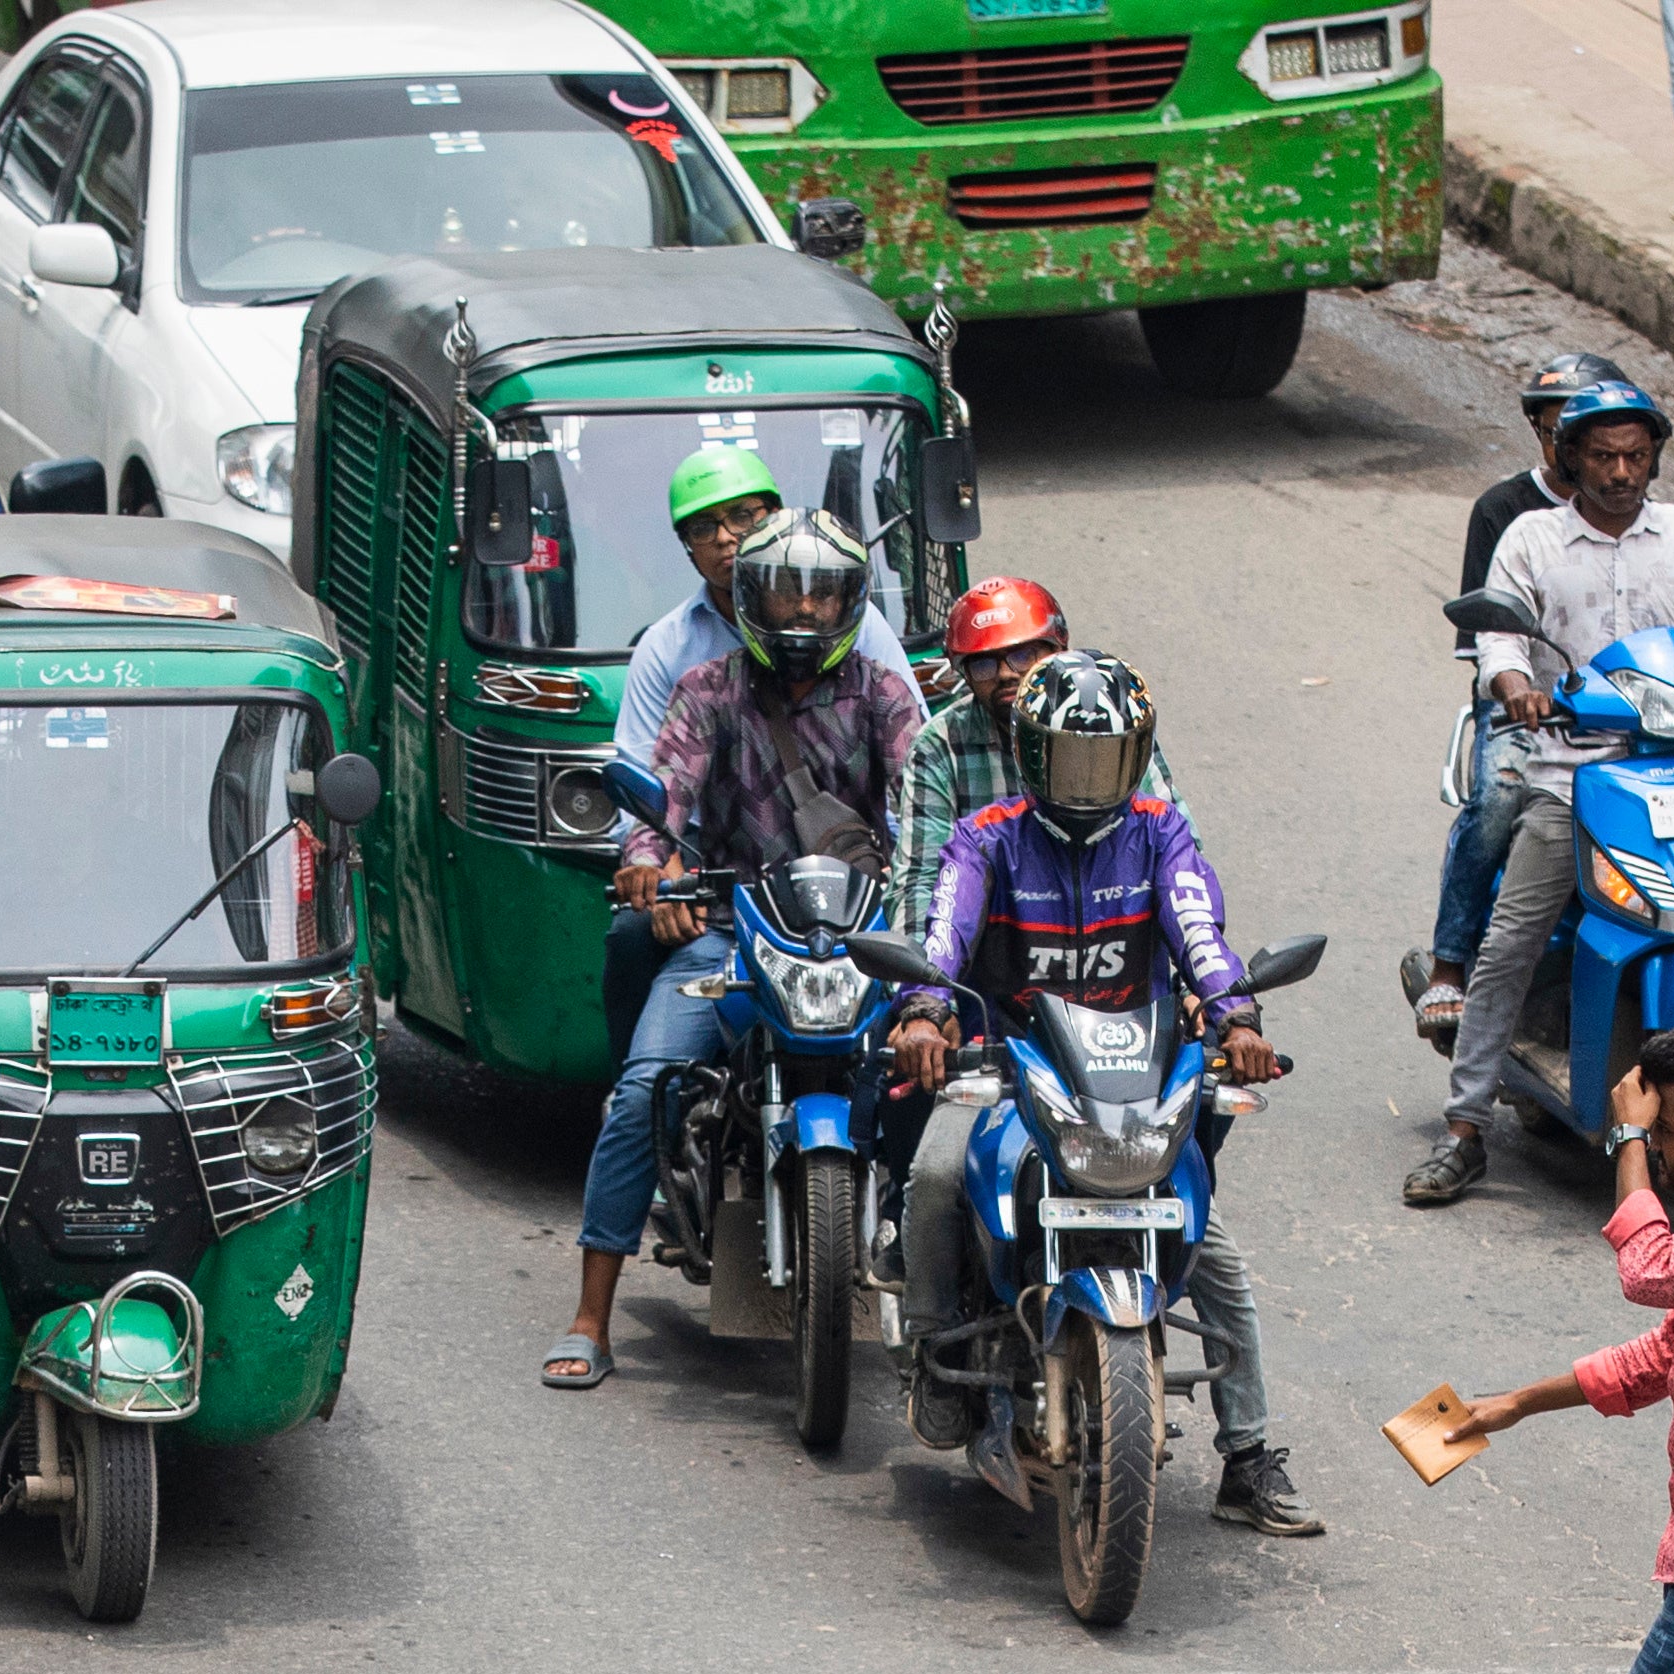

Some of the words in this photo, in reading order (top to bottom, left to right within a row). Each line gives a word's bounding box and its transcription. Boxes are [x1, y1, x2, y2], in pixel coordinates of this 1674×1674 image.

[1092, 884, 1125, 904] TVS
[1028, 940, 1127, 981] TVS
[1085, 1057, 1149, 1073] ALLAHU
[89, 1151, 128, 1173] RE
